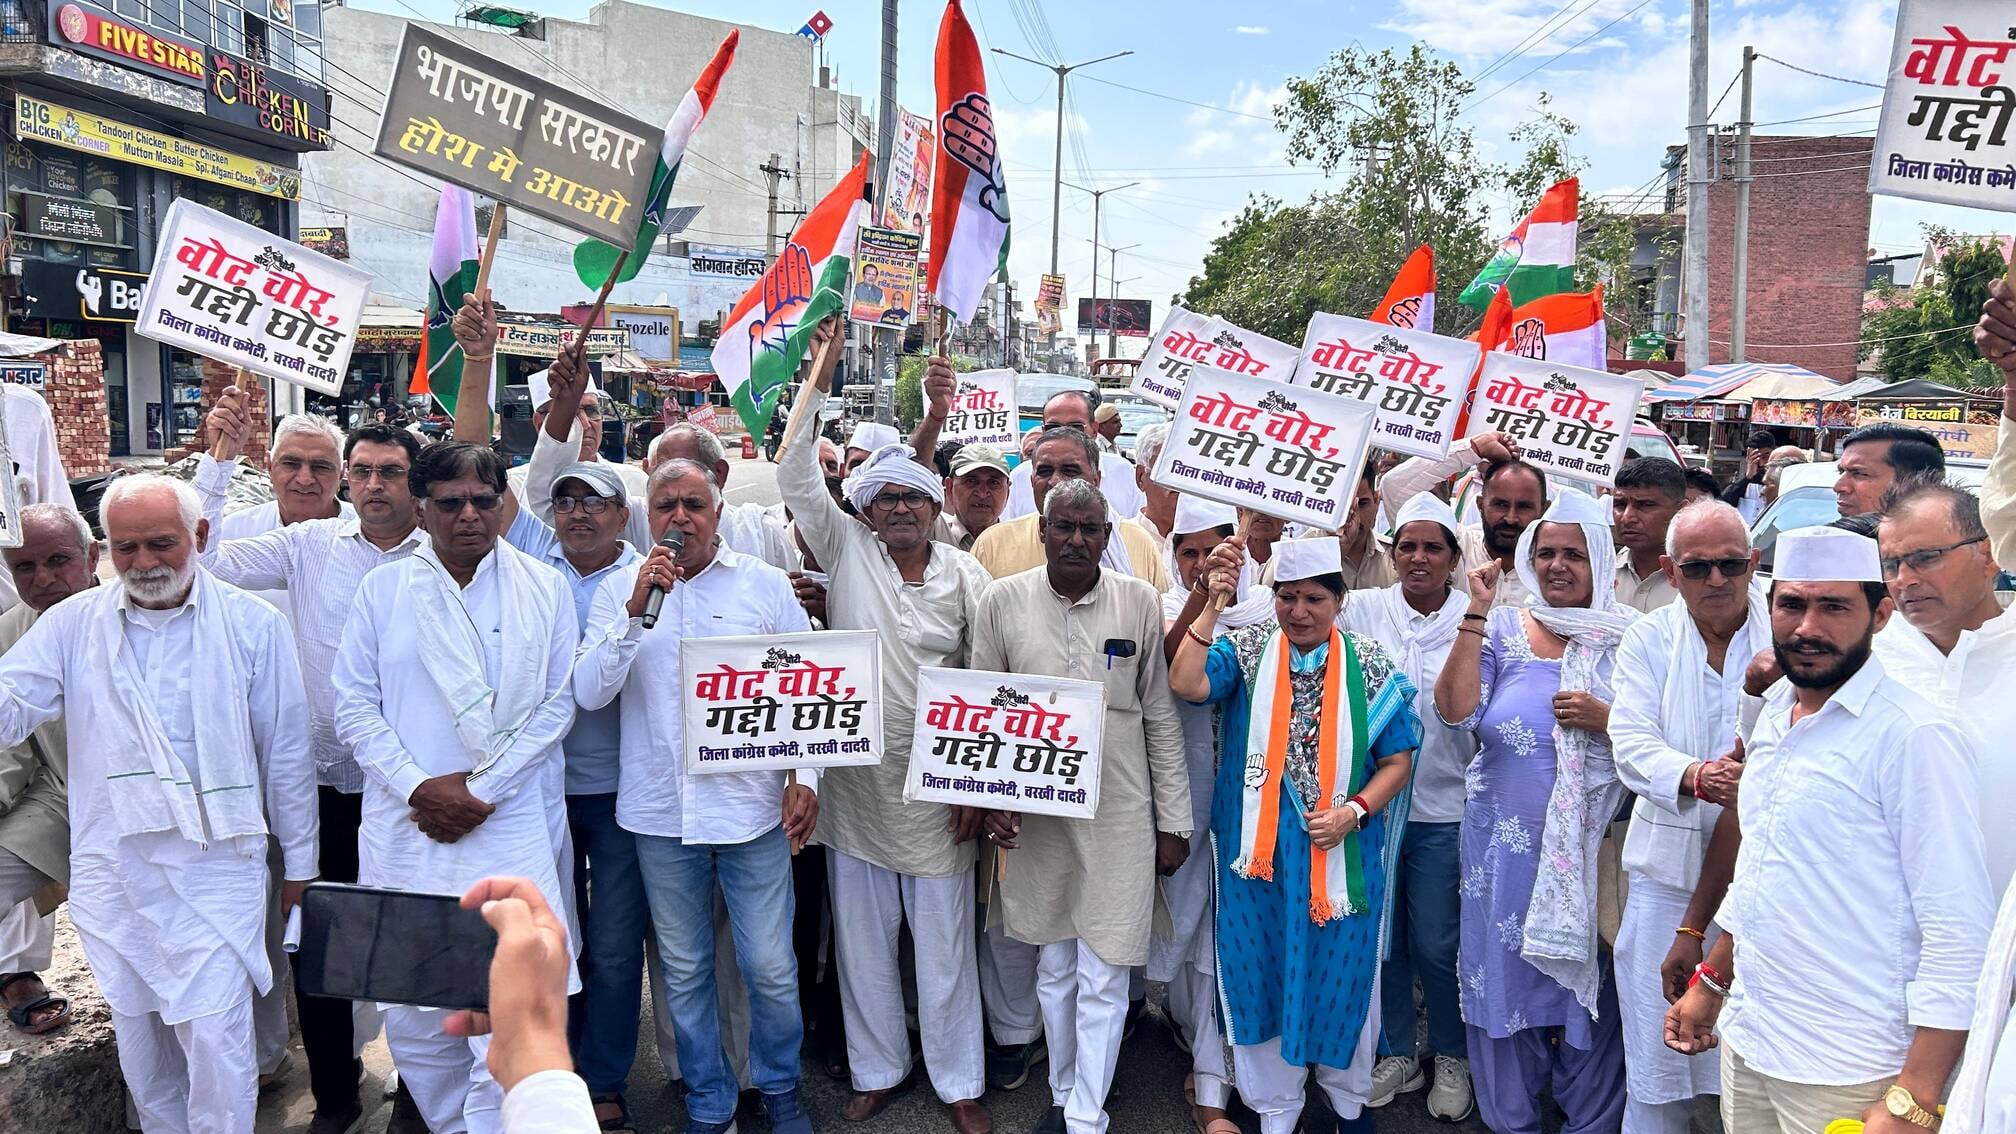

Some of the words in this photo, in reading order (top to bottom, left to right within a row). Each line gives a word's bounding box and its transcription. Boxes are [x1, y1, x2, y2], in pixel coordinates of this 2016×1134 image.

[100, 21, 148, 59] FIVE
[151, 39, 204, 76] STAR
[1904, 25, 2016, 88] वोट
[216, 67, 308, 122] CHICKEN
[240, 61, 266, 88] BIG
[19, 120, 62, 140] CHICKEN
[20, 99, 50, 125] BIG
[260, 106, 328, 144] CORNER
[417, 45, 535, 131] भाजपा
[540, 97, 646, 176] सरकार
[1907, 86, 2016, 151] गद्दी
[7, 153, 33, 170] PICY
[77, 135, 110, 152] CORNER
[97, 121, 133, 140] Tandoori
[135, 132, 167, 149] Chicken
[174, 141, 198, 157] Butter
[200, 148, 229, 165] Chicken
[123, 142, 153, 160] Mutton
[156, 152, 184, 168] Masala
[195, 160, 210, 174] Spl.
[211, 166, 233, 180] Afgani
[235, 171, 257, 186] Chaap
[50, 165, 66, 175] Your
[398, 116, 485, 169] होश
[487, 147, 523, 183] मे
[525, 166, 631, 225] आओ
[1888, 153, 1931, 180] जिला
[1933, 158, 1985, 186] कांग्रेस
[1987, 164, 2016, 190] कमे
[176, 237, 260, 287] वोट
[262, 270, 343, 327] चोर,
[692, 255, 734, 275] सांगवान
[734, 259, 766, 276] हॉस्पि
[176, 274, 263, 327] गद्दी
[263, 307, 346, 363] छोड़
[508, 326, 529, 341] टैन्ट
[158, 308, 191, 334] जिला
[194, 319, 231, 346] कांग्रेस
[233, 332, 269, 363] कमेटी,
[273, 350, 304, 372] चरखी
[308, 361, 338, 385] दादरी
[1163, 331, 1216, 363] वोट
[1311, 338, 1377, 373] वोट
[1379, 352, 1446, 395] चोर,
[952, 395, 962, 412] ट
[966, 388, 1004, 411] चोर,
[1141, 378, 1163, 394] जिला
[1379, 384, 1452, 427] छोड़
[1486, 376, 1548, 410] वोट
[1550, 389, 1613, 430] चोर,
[942, 410, 970, 433] द्दी
[974, 408, 1010, 432] छोड़
[1189, 392, 1263, 432] वोट
[1264, 410, 1340, 459] चोर,
[1385, 422, 1414, 438] चरखी
[1414, 429, 1442, 444] दादरी
[1485, 407, 1550, 440] गद्दी
[1552, 419, 1619, 460] छोड़
[1905, 407, 1961, 421] बिरयानी
[1188, 427, 1264, 467] गद्दी
[1265, 446, 1345, 494] छोड़
[1526, 447, 1554, 466] कमेटी,
[1558, 455, 1584, 471] चरखी
[1585, 461, 1612, 477] दादरी
[1170, 460, 1200, 479] जिला
[1201, 468, 1237, 489] कांग्रेस
[1235, 476, 1267, 500] कमेटी,
[1272, 487, 1302, 506] चरखी
[1305, 496, 1336, 515] दादरी
[696, 664, 770, 701] वोट
[778, 660, 856, 701] चोर,
[706, 696, 783, 737] गद्दी
[792, 693, 868, 736] छोड़
[926, 695, 997, 734] वोट
[1003, 702, 1079, 749] चोर,
[699, 745, 729, 761] जिला
[732, 742, 765, 760] कांग्रेस
[768, 740, 804, 759] कमेटी,
[807, 739, 838, 755] चरखी
[841, 737, 871, 753] दादरी
[932, 731, 1006, 772] गद्दी
[1012, 738, 1088, 785] छोड़
[922, 772, 950, 790] जिला
[953, 775, 985, 794] कांग्रेस
[987, 779, 1021, 799] कमेटी,
[1024, 785, 1055, 800] चरखी
[1058, 788, 1087, 804] दादरी
